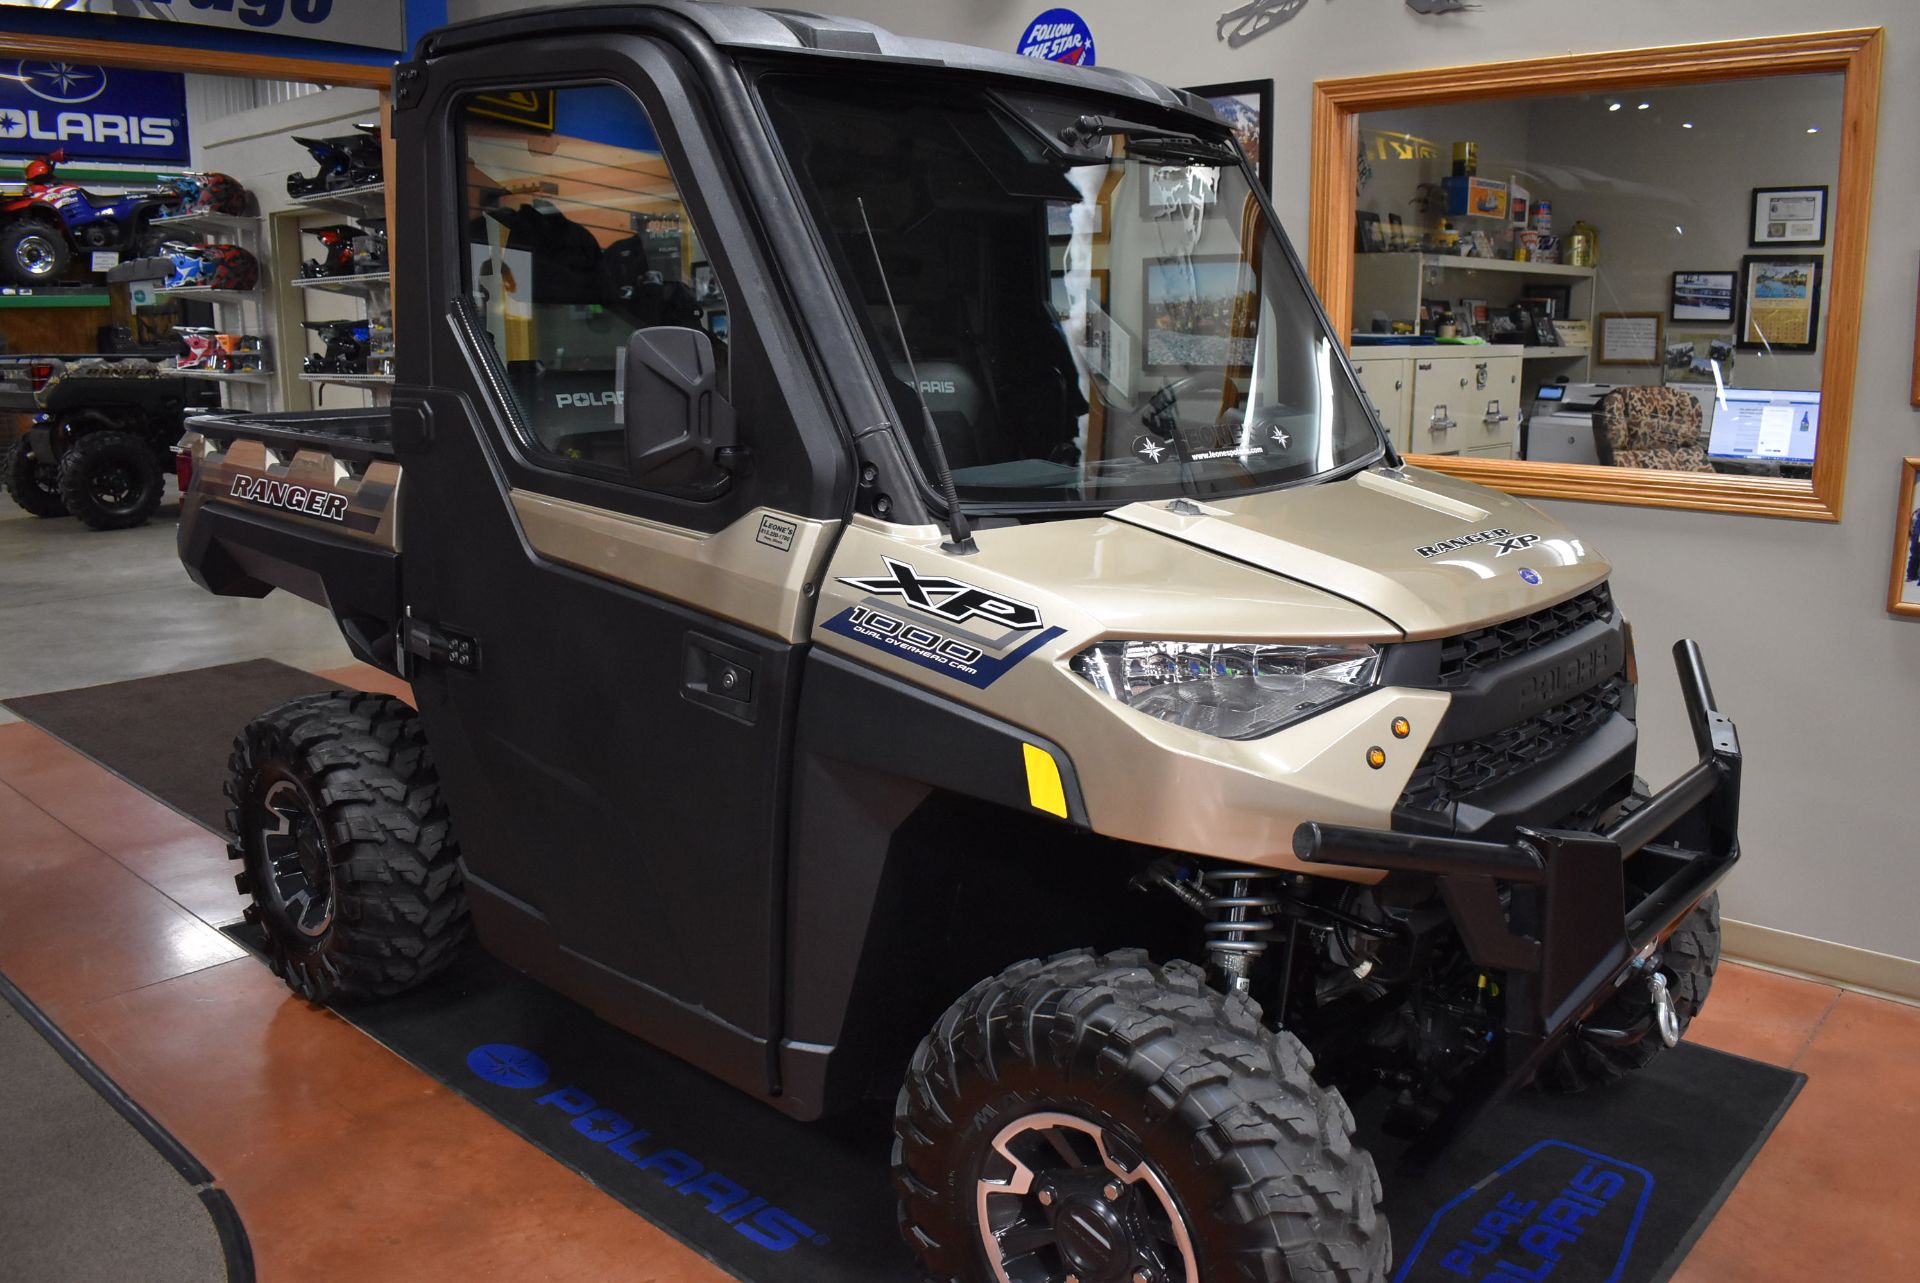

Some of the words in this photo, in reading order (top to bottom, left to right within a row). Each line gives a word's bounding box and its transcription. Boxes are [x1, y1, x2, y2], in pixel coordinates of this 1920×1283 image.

[1023, 41, 1052, 59] THE
[1047, 33, 1082, 58] STAR
[1027, 23, 1074, 44] FOLLOW
[1191, 447, 1264, 461] www.leonespola.com
[230, 474, 348, 521] RANGER
[1414, 528, 1513, 558] RANGER
[1488, 534, 1541, 557] XP
[832, 554, 1044, 631] XP
[848, 605, 983, 665] 1000
[853, 625, 882, 641] DUAL
[885, 636, 949, 665] OVERHEAD
[948, 660, 978, 675] CAM
[534, 1086, 818, 1251] POLARIS
[1439, 1191, 1538, 1277] PURE
